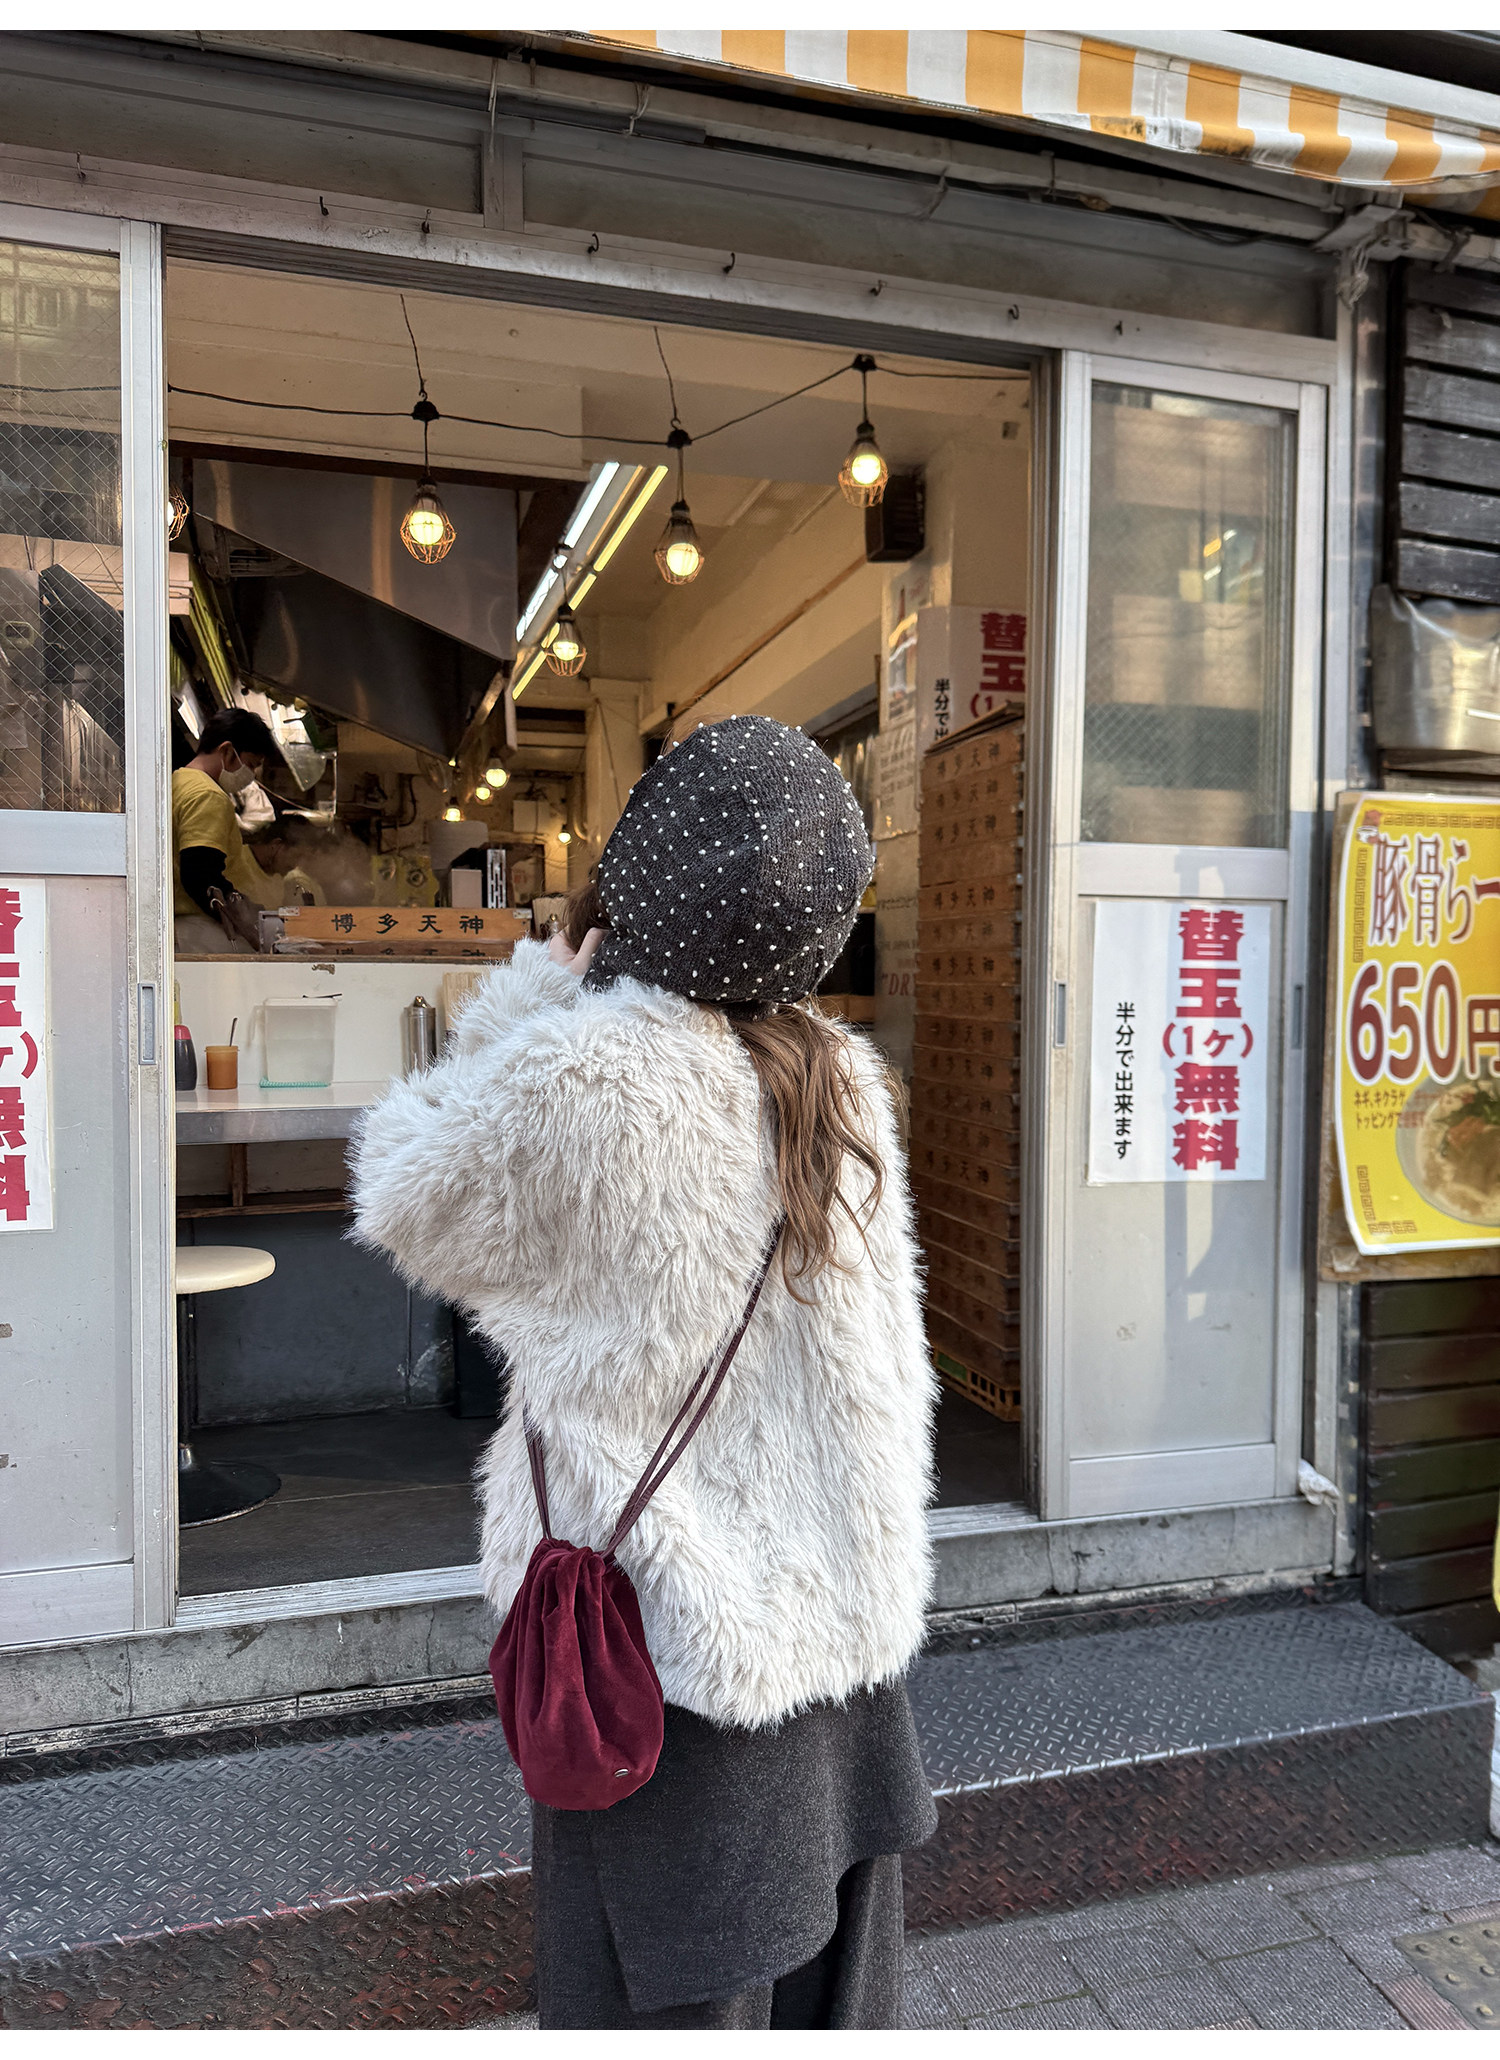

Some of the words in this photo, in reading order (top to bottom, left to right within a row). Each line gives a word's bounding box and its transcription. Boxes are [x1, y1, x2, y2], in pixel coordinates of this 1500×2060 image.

[331, 913, 484, 934] 博多天神
[1351, 965, 1500, 1080] 650円
[1114, 1002, 1135, 1159] 半分で出来ます
